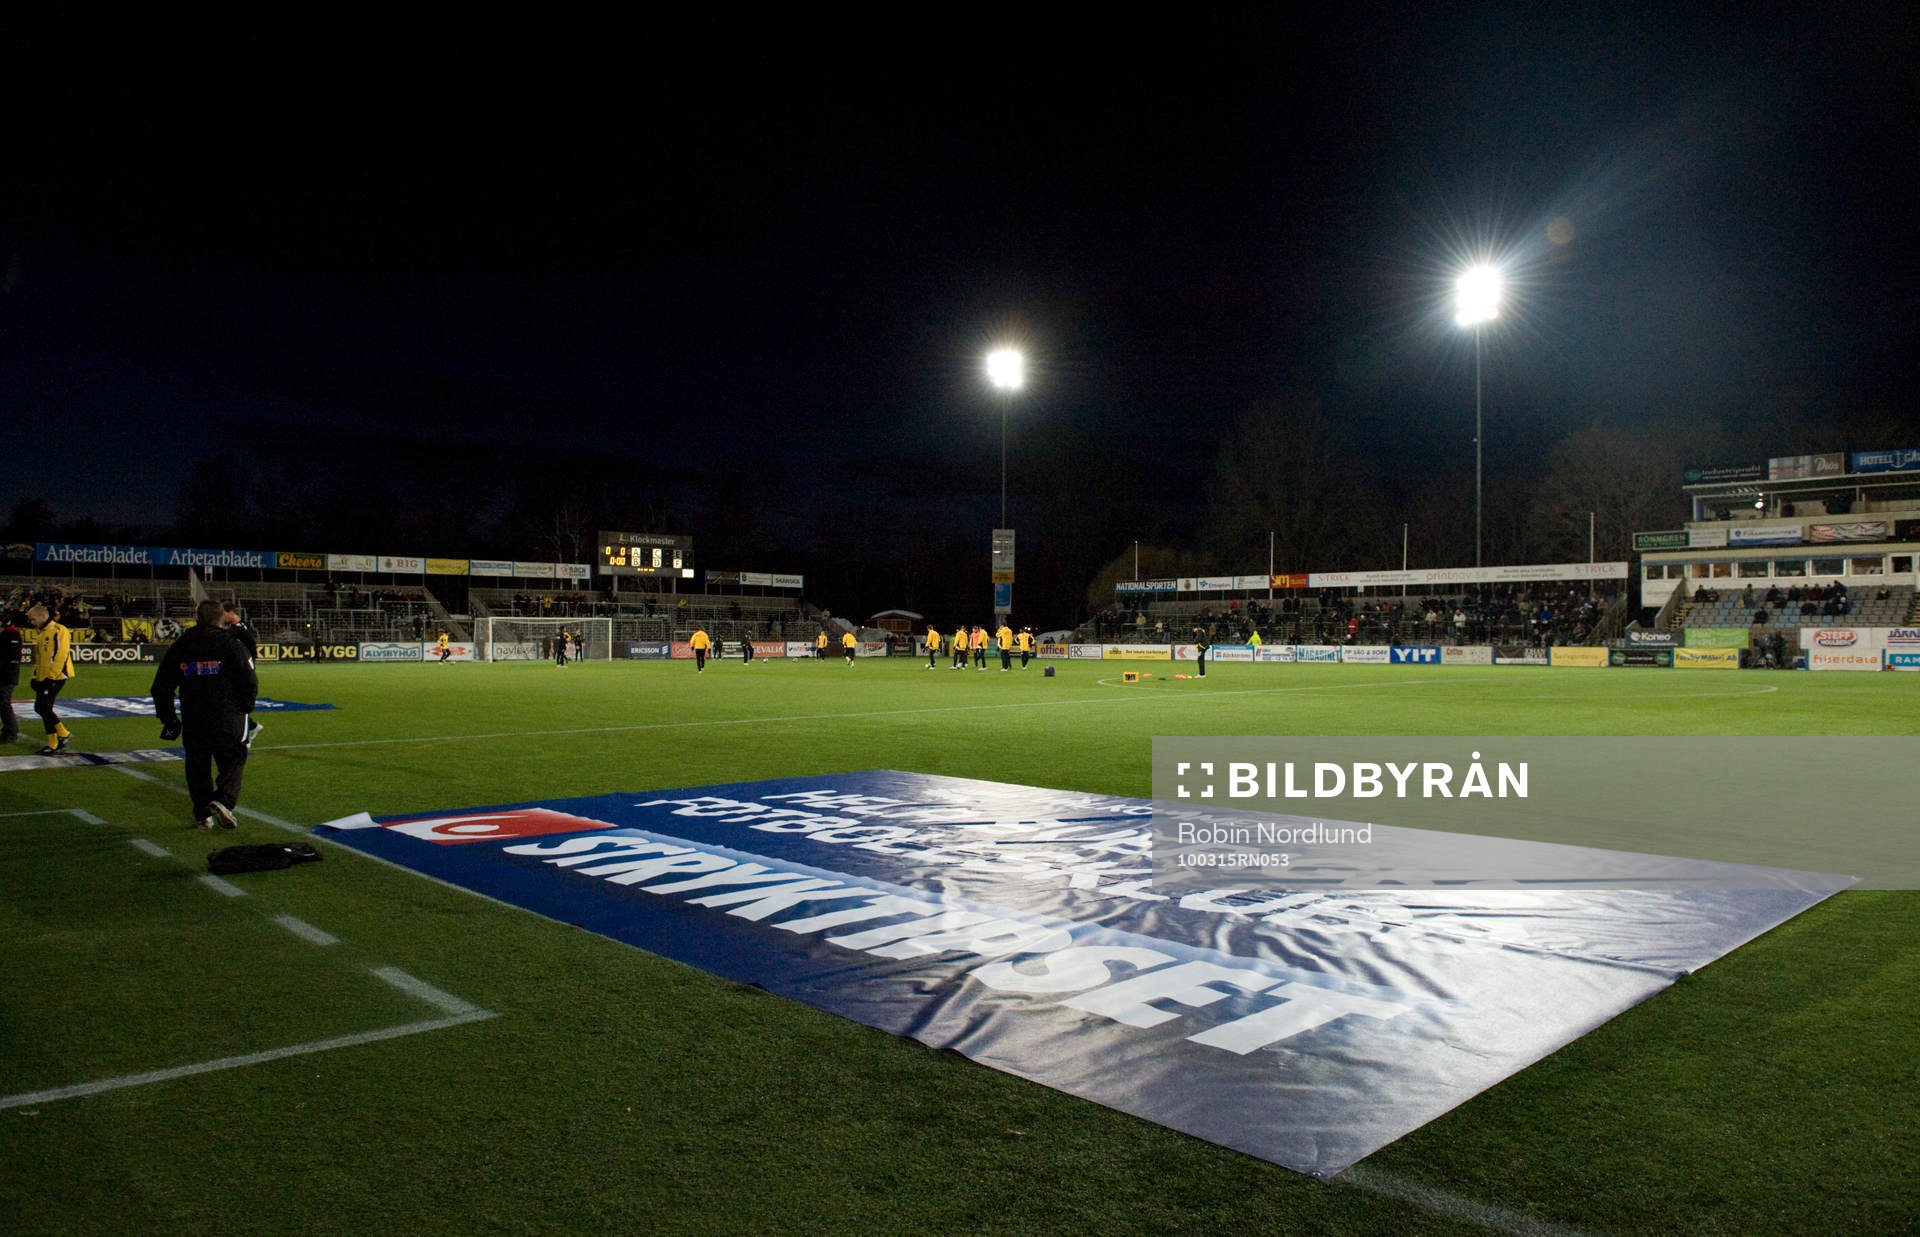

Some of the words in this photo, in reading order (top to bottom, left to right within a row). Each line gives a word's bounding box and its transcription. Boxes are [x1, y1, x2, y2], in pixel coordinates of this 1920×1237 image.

[1860, 455, 1893, 465] HOTELL
[630, 534, 675, 545] Klockmaster
[46, 544, 148, 567] Arbetarbladet
[169, 549, 264, 569] Arbetarbladet
[1115, 581, 1177, 591] NATIONALSPORTEN
[1641, 632, 1671, 641] Koneo
[1820, 632, 1853, 640] STEFF
[71, 645, 155, 664] nterpool.se
[630, 647, 660, 655] ERICSSON
[1040, 645, 1065, 655] office
[1394, 648, 1436, 662] YIT
[503, 836, 1415, 1055] STRYKTIPSET
